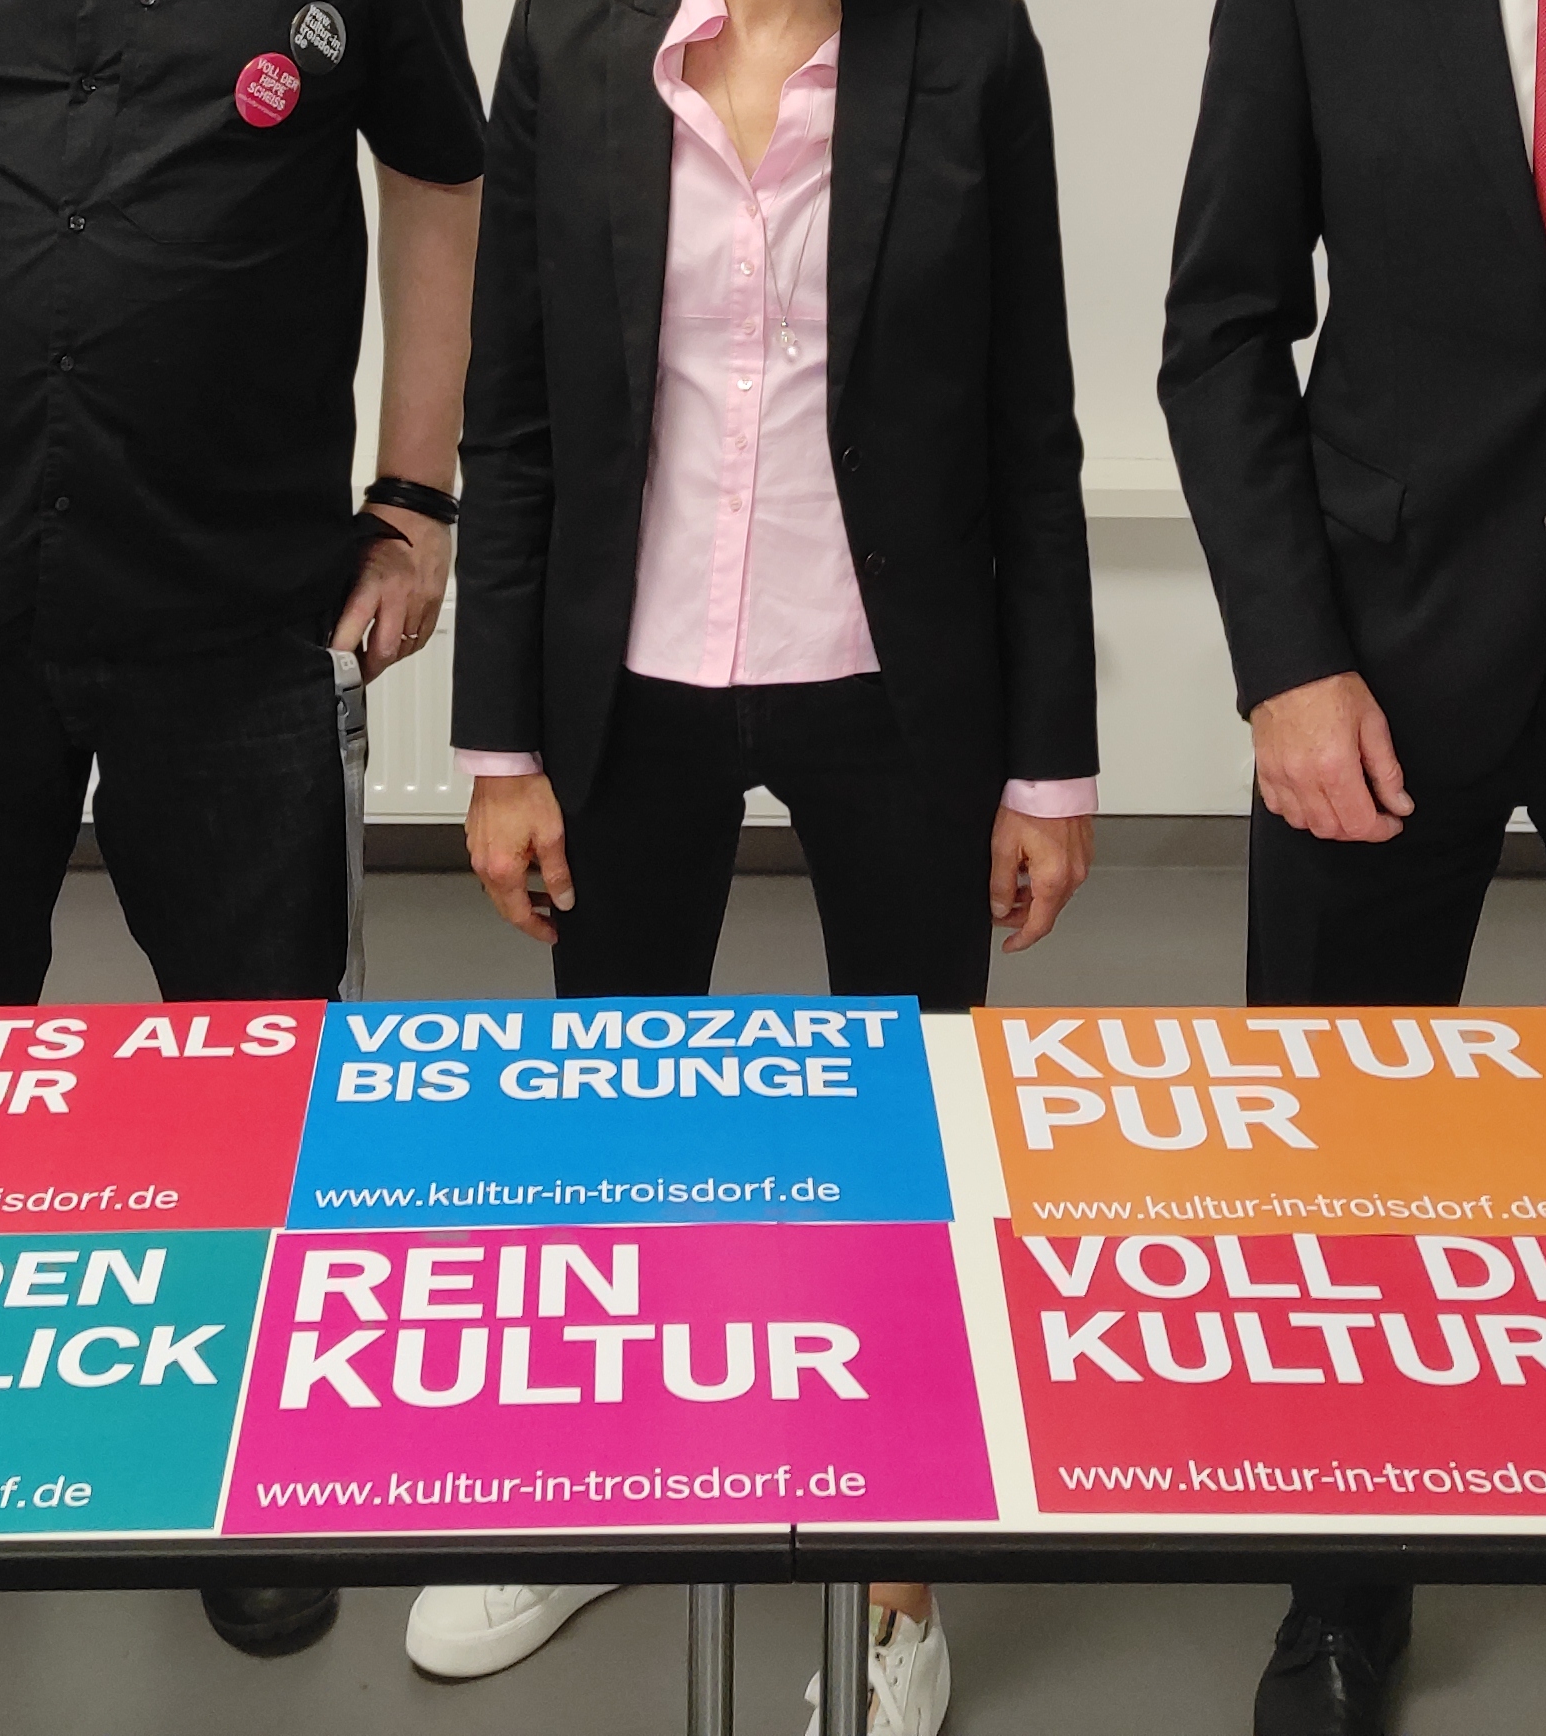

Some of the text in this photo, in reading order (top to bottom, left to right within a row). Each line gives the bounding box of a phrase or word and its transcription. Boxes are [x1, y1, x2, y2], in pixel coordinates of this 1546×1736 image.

[257, 58, 280, 80] VOLL
[114, 1015, 296, 1057] ALS
[347, 1010, 898, 1052] VON MOZART
[1002, 1019, 1541, 1078] KULTUR
[337, 1057, 857, 1101] BIS GRUNGE
[1017, 1085, 1317, 1150] PUR
[316, 1177, 839, 1207] www.kultur-in-troisdorf.de
[295, 1244, 638, 1322] REIN
[1022, 1233, 1382, 1299] VOLL
[280, 1322, 868, 1409] KULTUR
[257, 1466, 865, 1506] www.kultur-in-troisdorf.de
